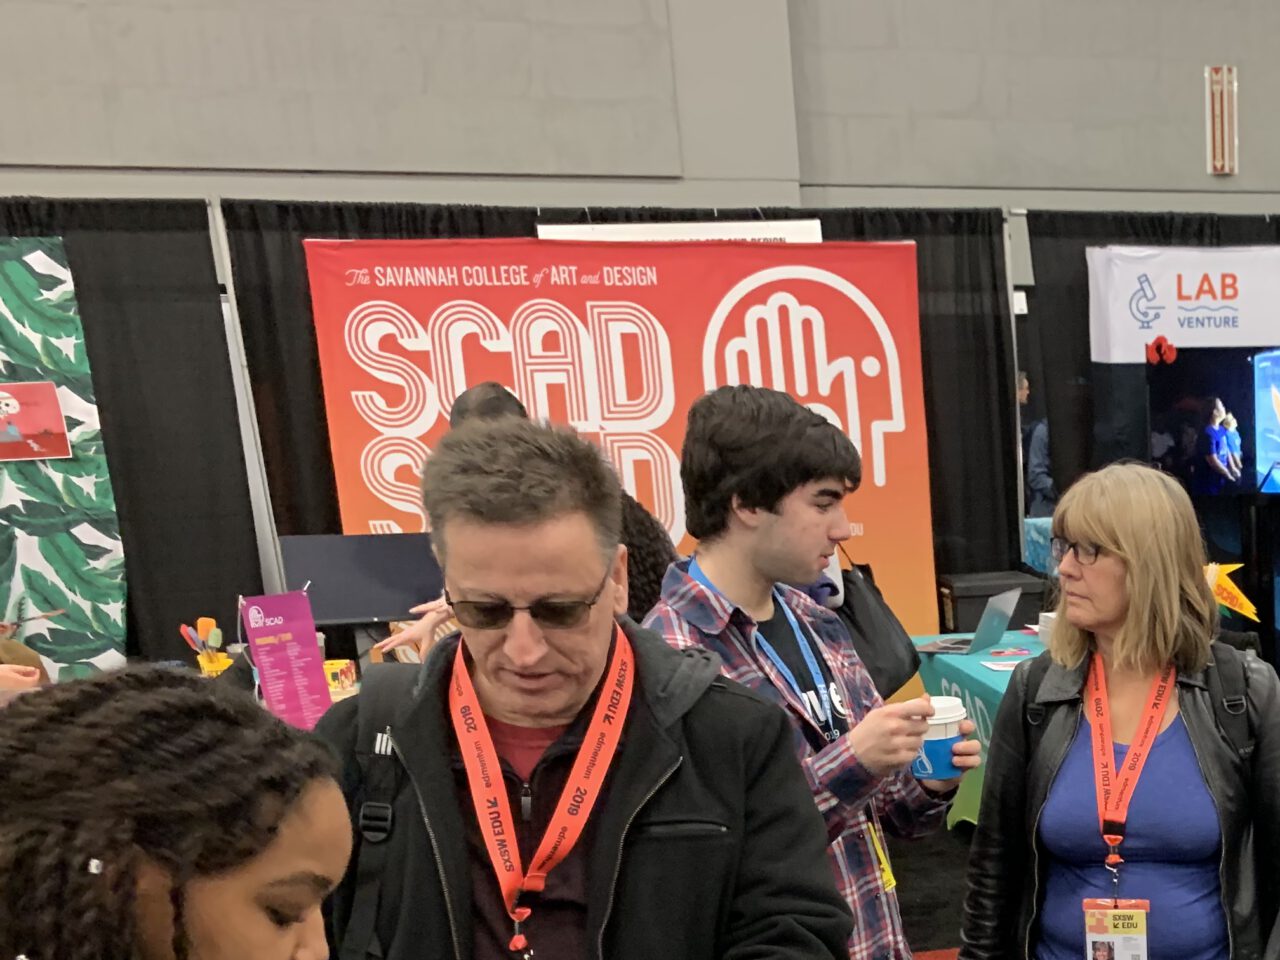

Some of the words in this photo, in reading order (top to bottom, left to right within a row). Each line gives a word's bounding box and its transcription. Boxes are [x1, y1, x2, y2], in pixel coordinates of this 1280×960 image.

[345, 268, 371, 285] The
[374, 266, 458, 287] SAVANNAH
[462, 265, 530, 287] COLLEGE
[532, 268, 548, 288] of
[550, 266, 578, 286] ART
[580, 271, 600, 285] and
[603, 266, 658, 287] DESIGN
[1176, 272, 1240, 301] LAB
[1177, 316, 1239, 329] VENTURE
[344, 298, 677, 442] SCAD
[616, 659, 629, 689] SXSW
[607, 687, 624, 716] EDU
[460, 705, 478, 734] 2019
[1128, 751, 1142, 772] 2019
[567, 787, 588, 817] 2019
[489, 808, 505, 836] EDU
[496, 835, 515, 873] SXSW
